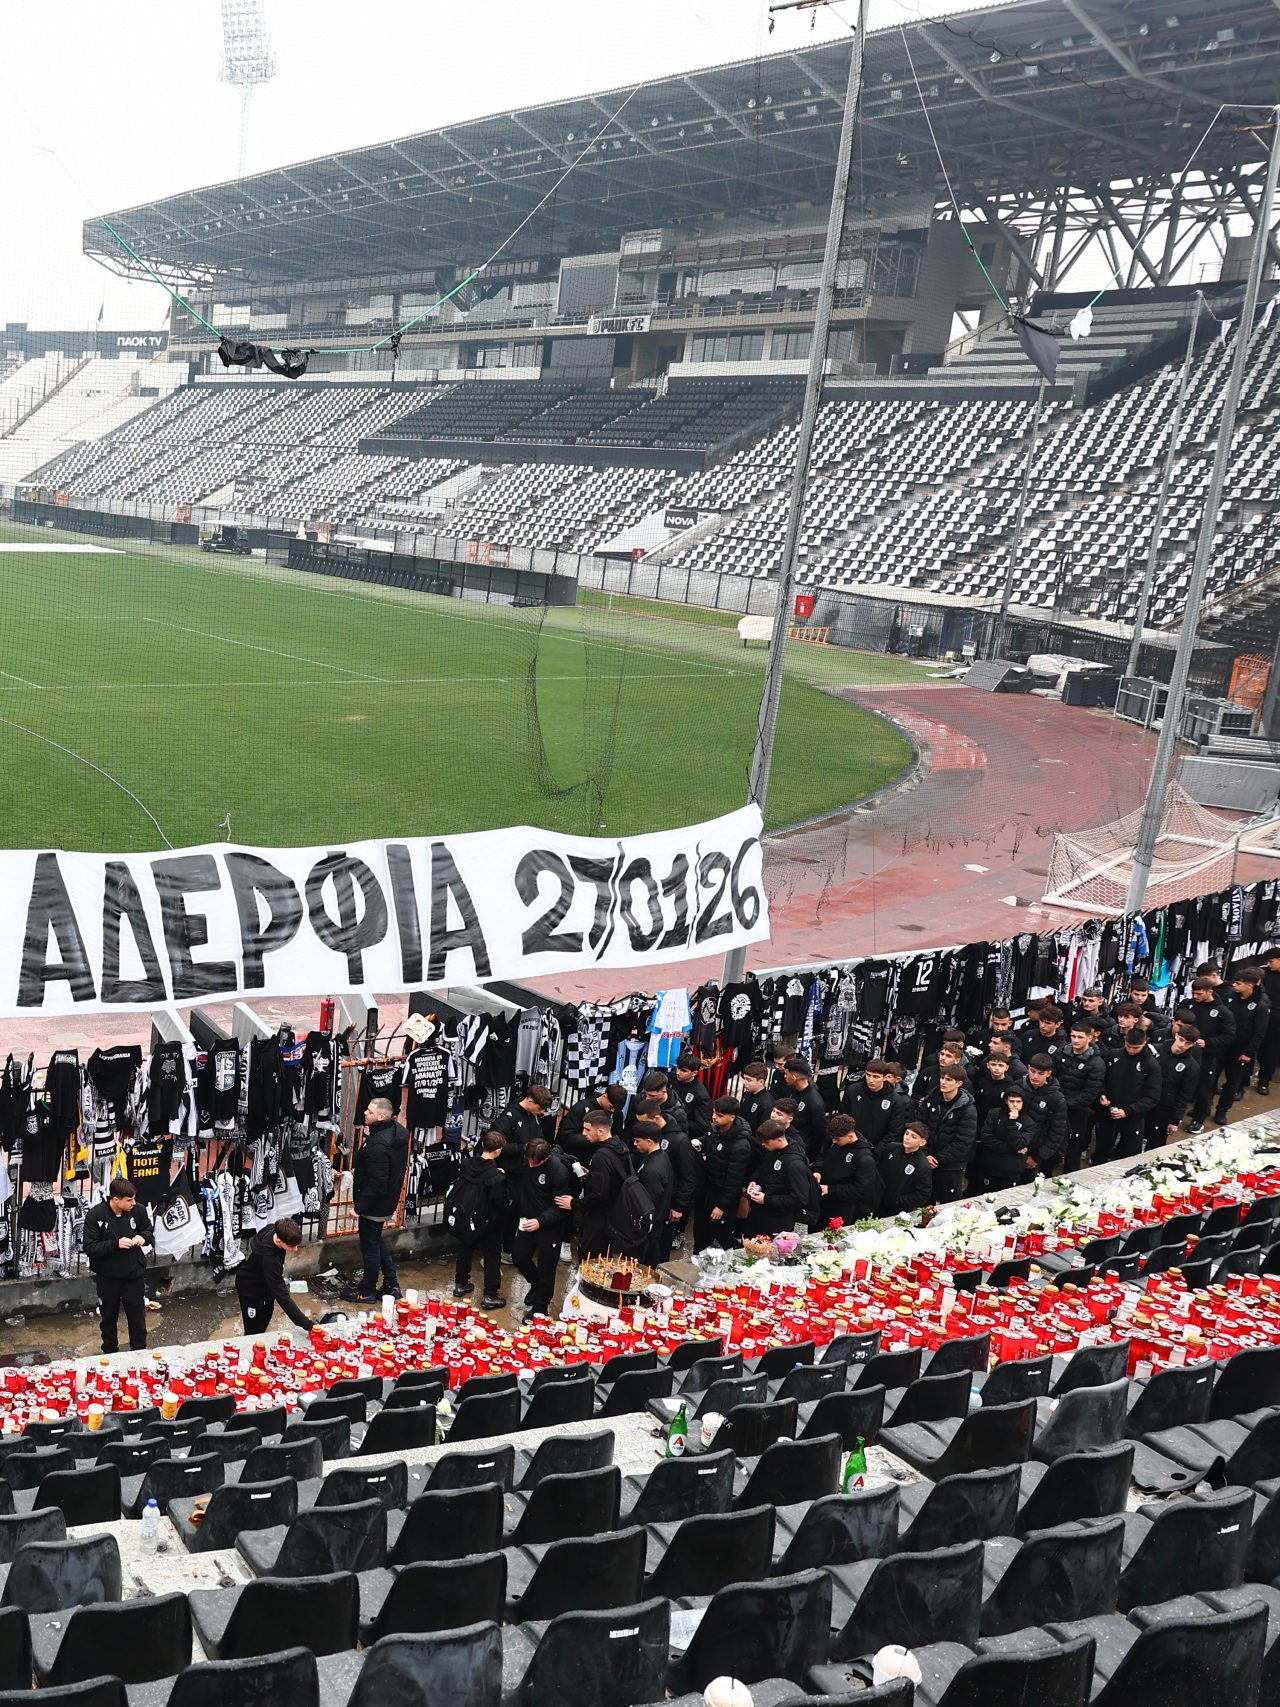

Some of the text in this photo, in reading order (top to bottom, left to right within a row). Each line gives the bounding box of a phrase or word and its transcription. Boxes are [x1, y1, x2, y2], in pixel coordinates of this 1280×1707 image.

[117, 337, 163, 346] ΠΑΟΚ TV
[666, 516, 695, 526] NOVA
[16, 842, 492, 1008] ΑΔΕΡΦΙΑ
[516, 837, 762, 961] 27/01/26
[916, 959, 934, 986] 12
[133, 1158, 159, 1167] ΠΟΤΕ
[133, 1168, 160, 1178] ΞΑΝΑ
[232, 1214, 240, 1236] 1926
